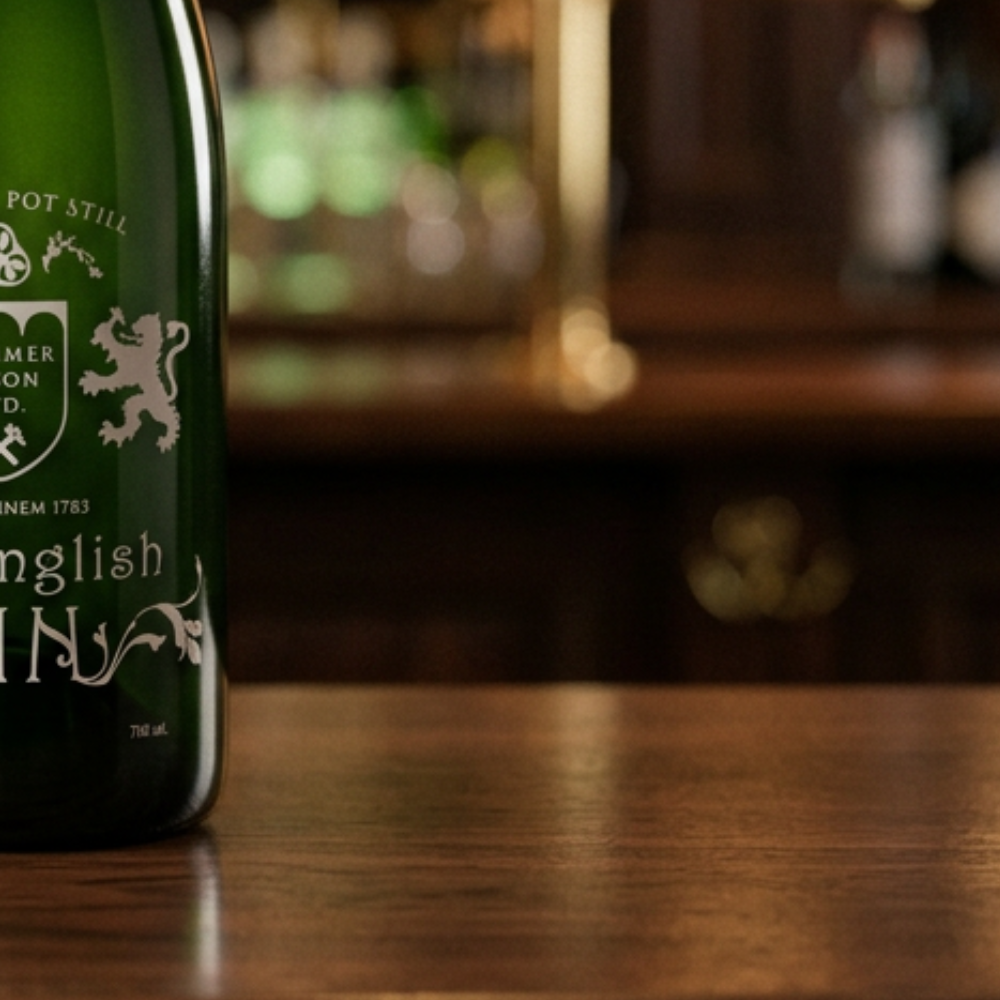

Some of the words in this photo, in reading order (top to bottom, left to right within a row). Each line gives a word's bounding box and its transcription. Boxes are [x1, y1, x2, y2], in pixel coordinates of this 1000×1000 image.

[7, 191, 59, 212] POT
[66, 198, 126, 235] STILL
[53, 500, 90, 515] 1783
